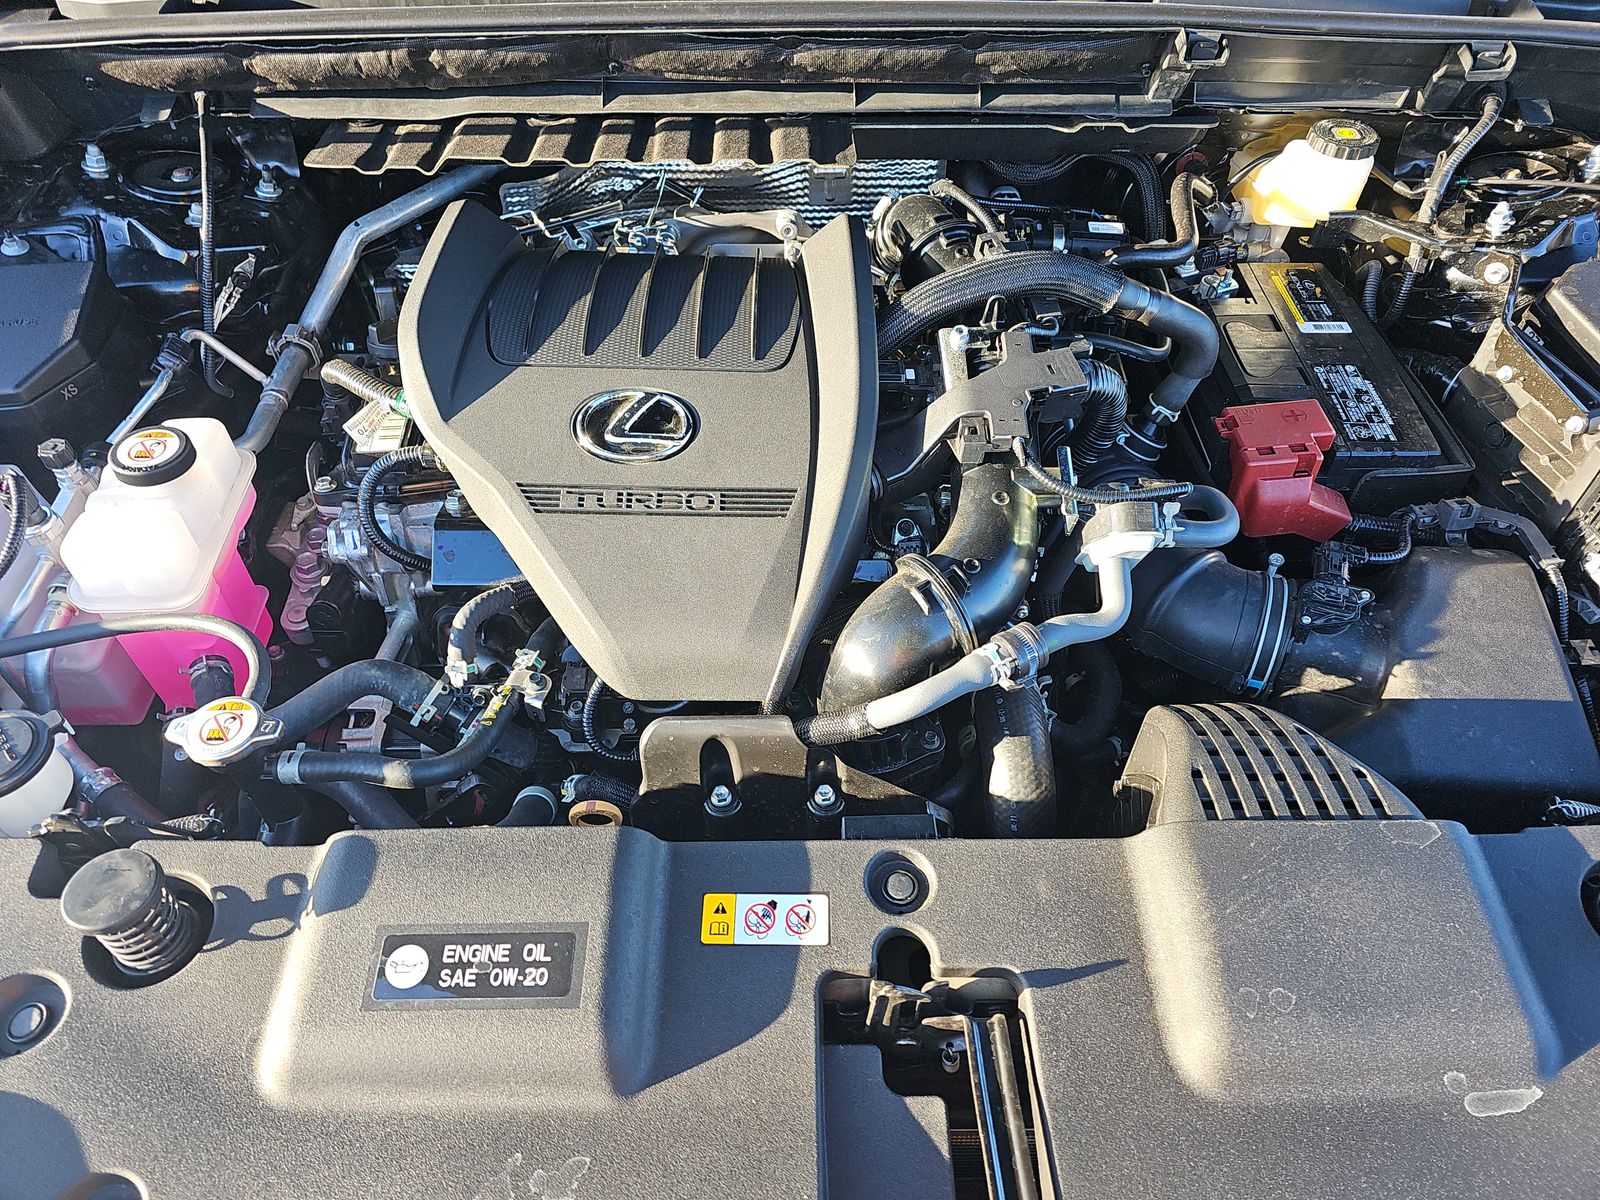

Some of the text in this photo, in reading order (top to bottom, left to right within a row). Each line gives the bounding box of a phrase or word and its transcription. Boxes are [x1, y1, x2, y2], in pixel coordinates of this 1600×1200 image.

[564, 491, 716, 511] TURBO
[442, 943, 552, 964] ENGINE OIL
[438, 967, 549, 988] SAE 0W-20
